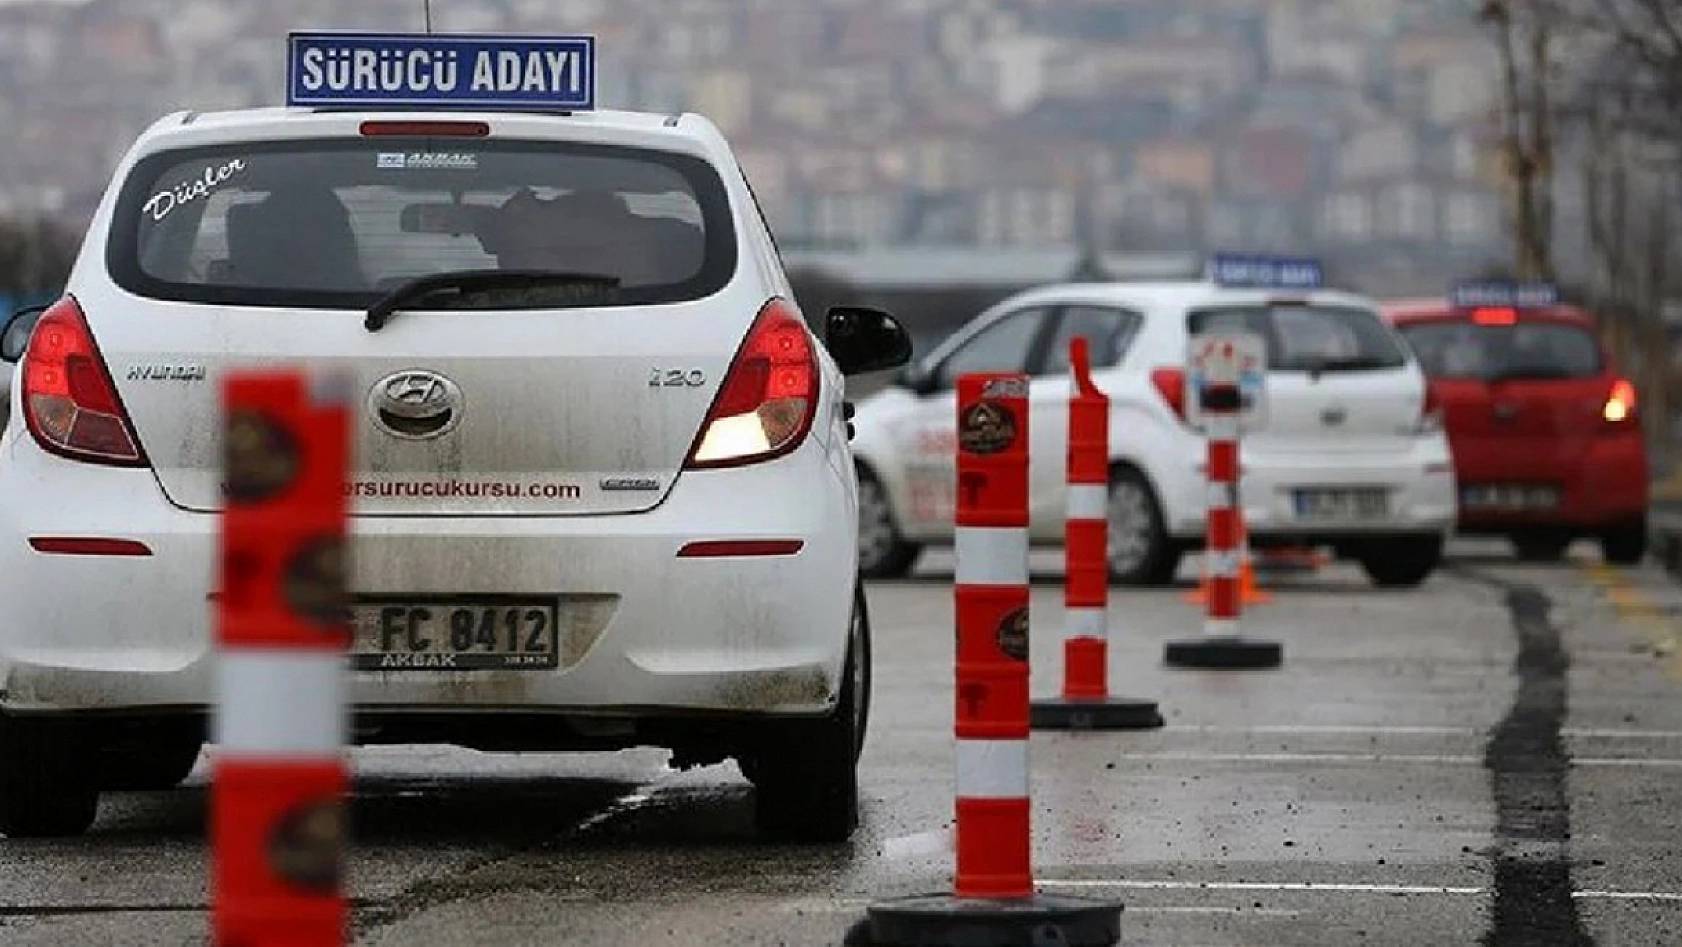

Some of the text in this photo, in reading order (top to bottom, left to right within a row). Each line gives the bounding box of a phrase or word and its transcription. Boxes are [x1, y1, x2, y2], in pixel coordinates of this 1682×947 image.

[303, 47, 579, 92] SÜRÜCÜ ADAYI
[648, 367, 707, 387] i20
[381, 607, 548, 652] FC 8412
